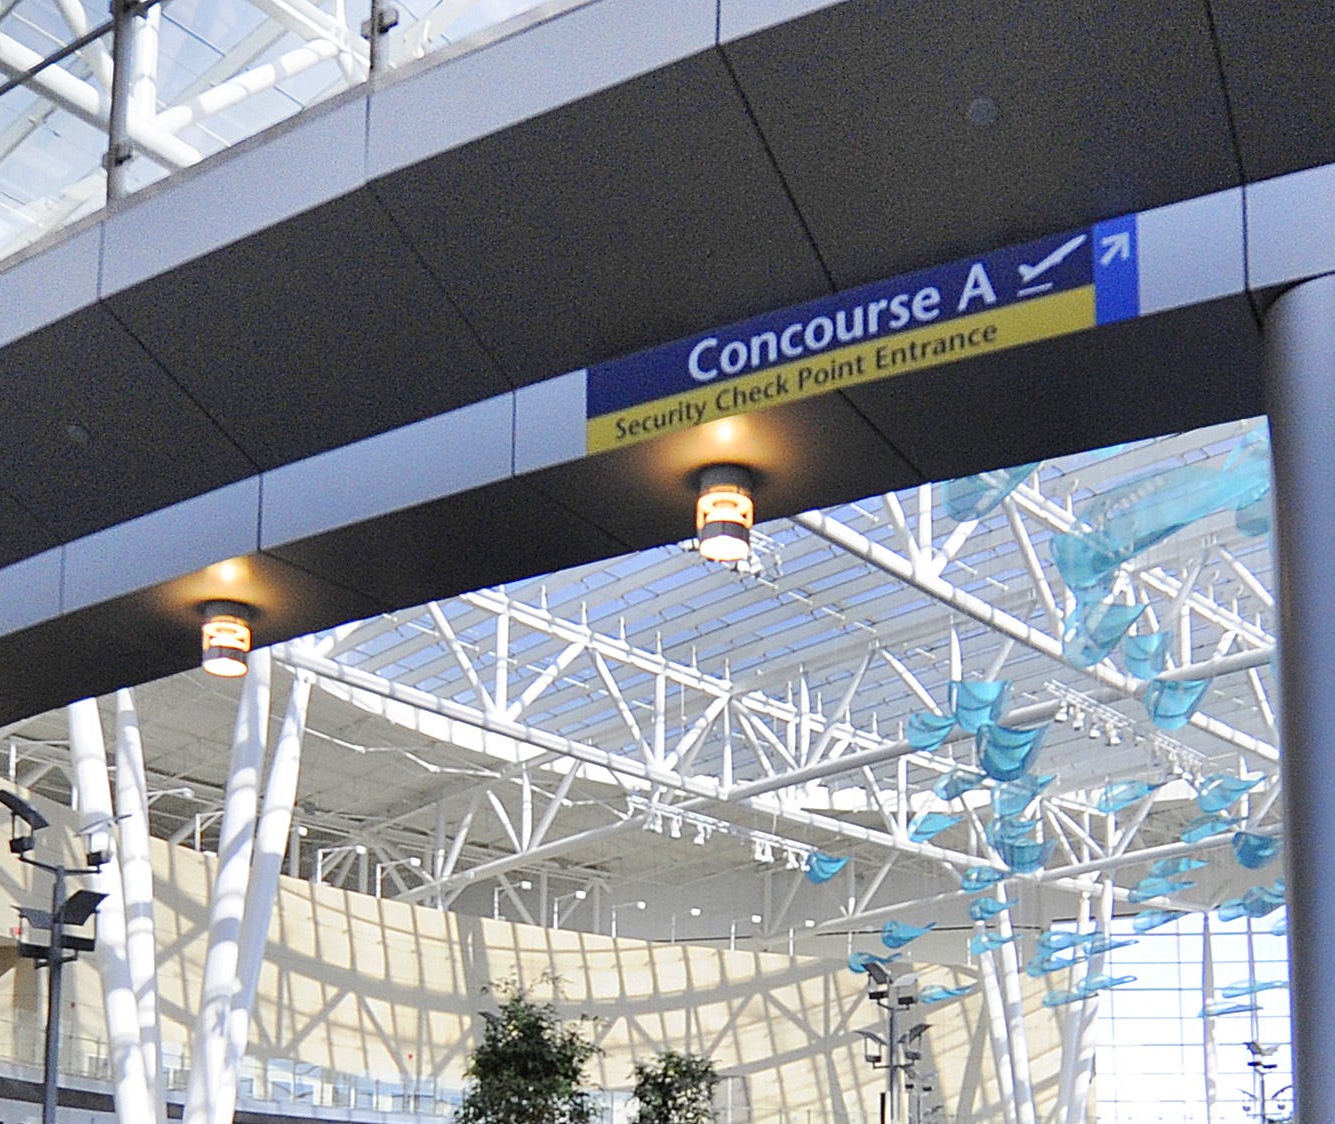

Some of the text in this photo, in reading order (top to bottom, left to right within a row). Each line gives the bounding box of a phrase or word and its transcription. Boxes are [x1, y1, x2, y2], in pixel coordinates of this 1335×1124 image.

[688, 262, 998, 382] Concourse A
[615, 325, 998, 440] Security Check Point Entrance
